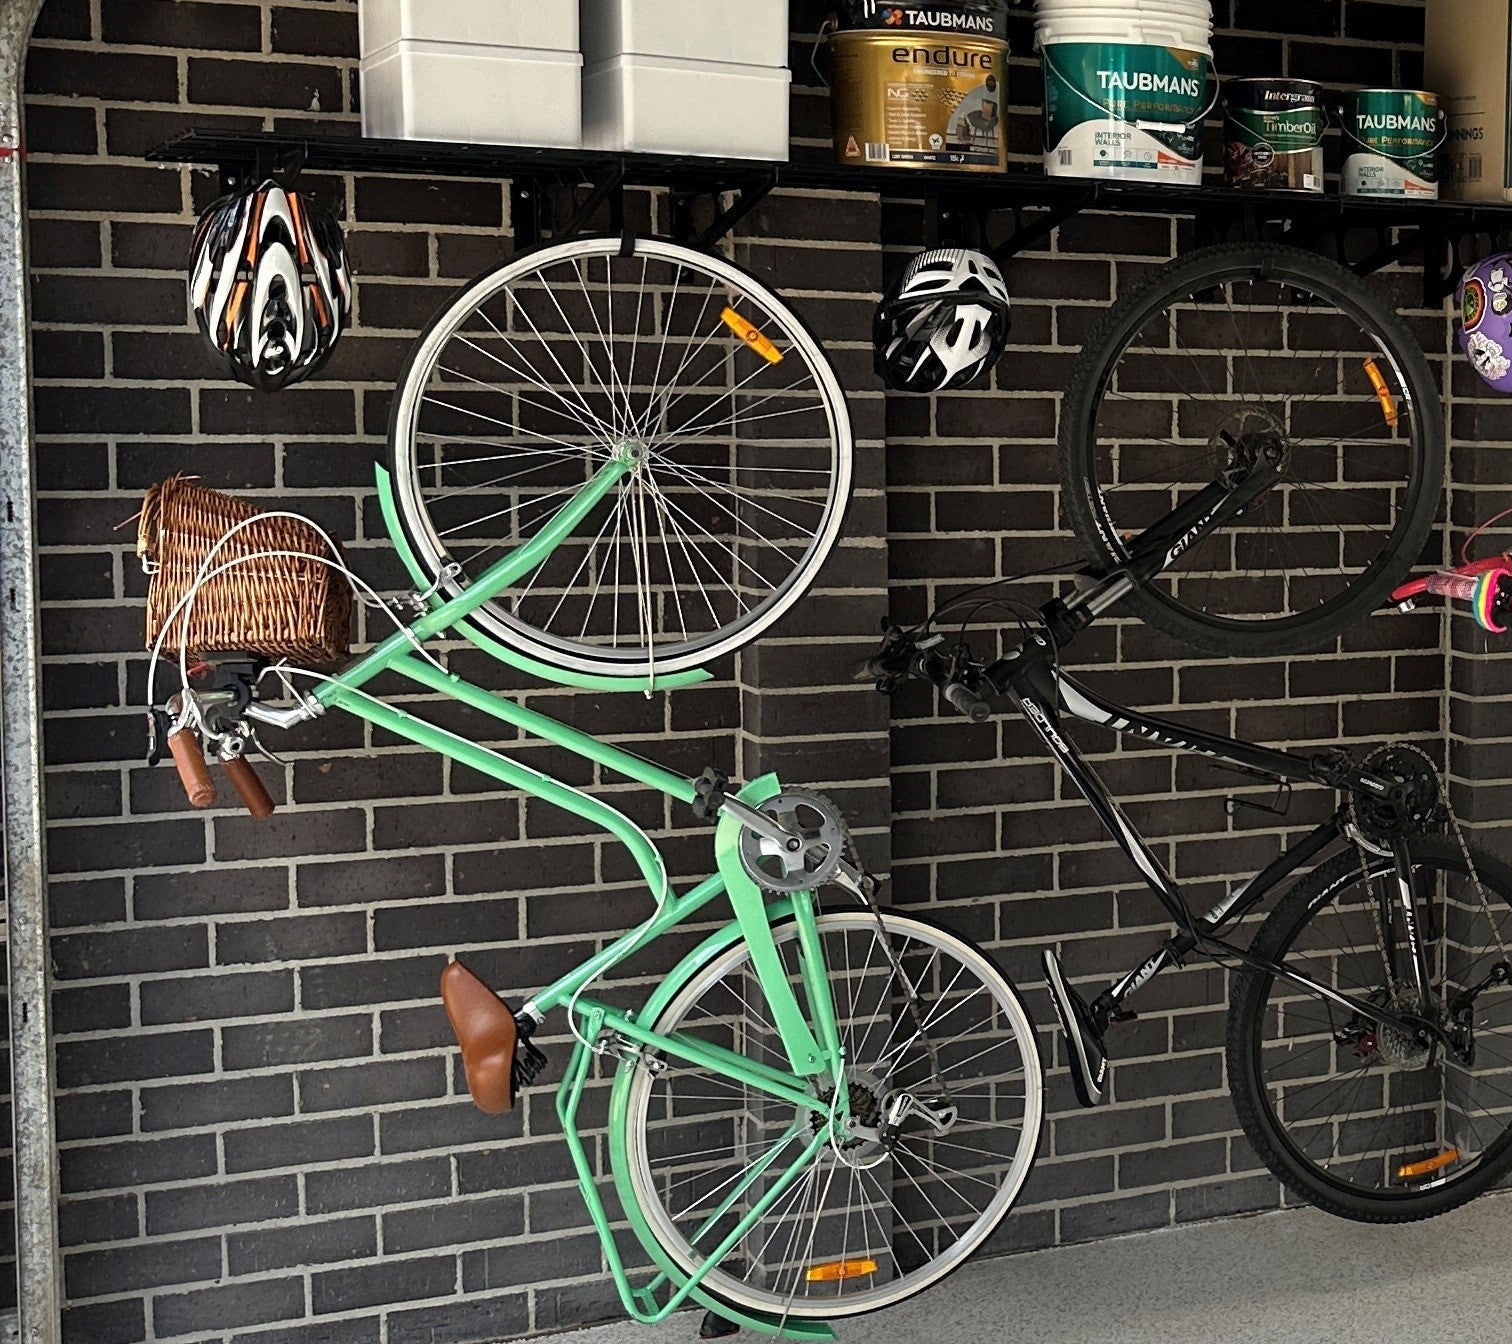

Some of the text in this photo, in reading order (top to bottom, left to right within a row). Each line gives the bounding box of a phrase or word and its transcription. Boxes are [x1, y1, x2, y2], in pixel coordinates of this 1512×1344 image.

[905, 10, 994, 32] TAUBMANS
[892, 46, 993, 70] endure
[1096, 70, 1199, 97] TAUBMANS
[1356, 114, 1436, 133] TAUBMANS
[1021, 696, 1070, 755] BOULDER
